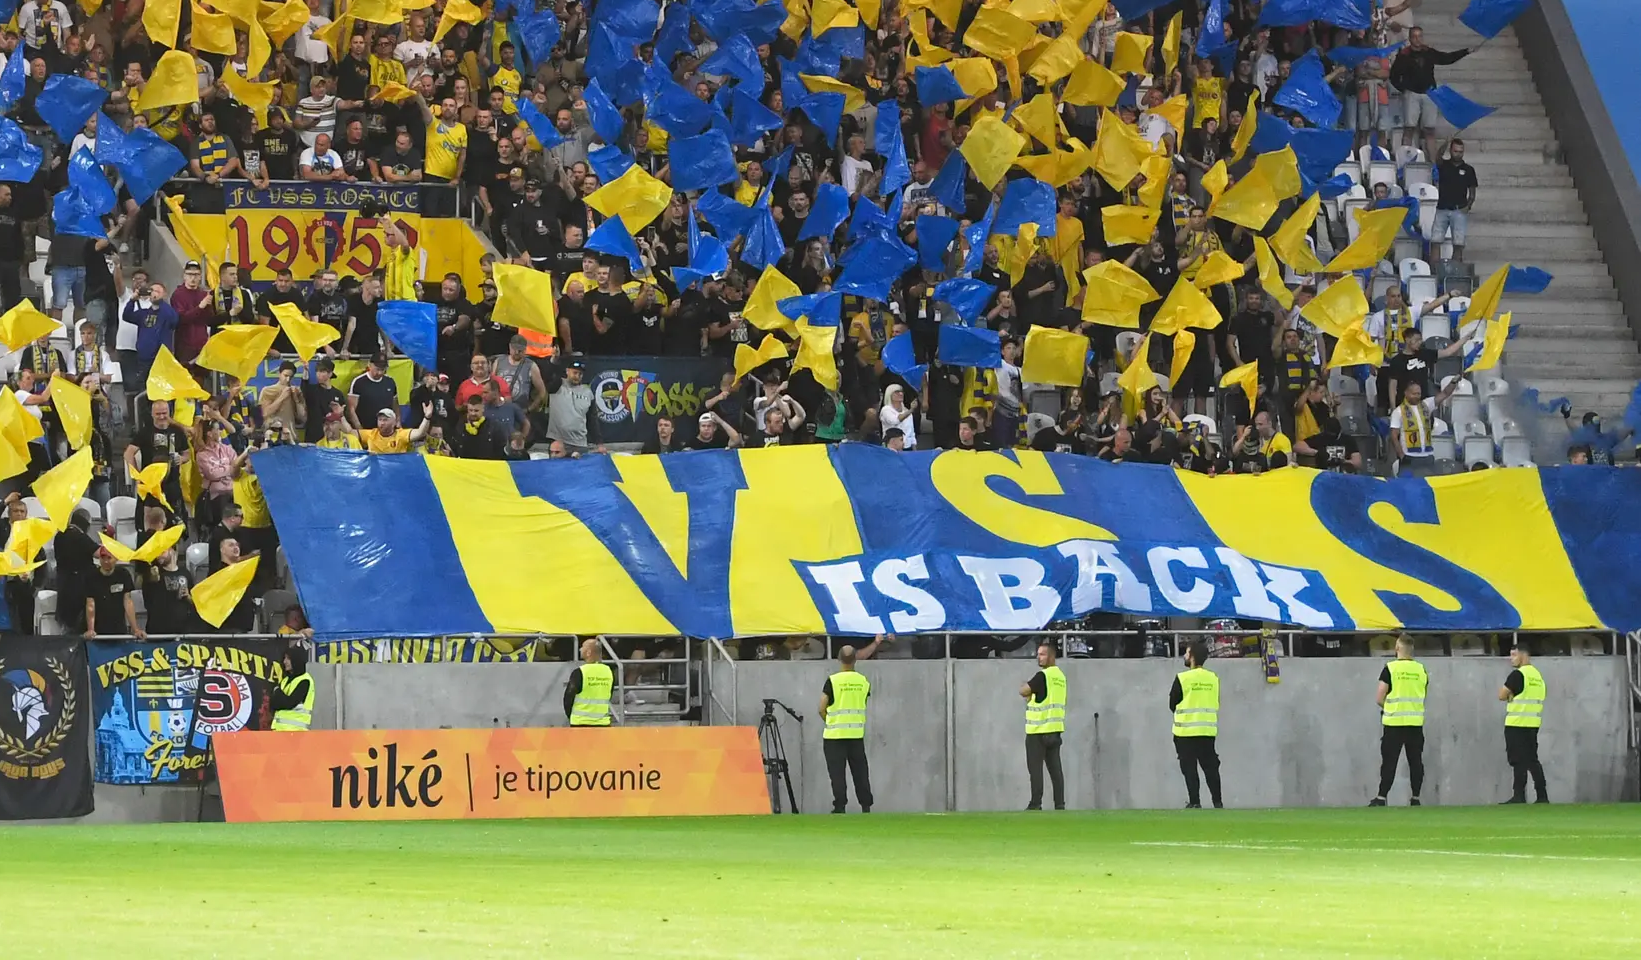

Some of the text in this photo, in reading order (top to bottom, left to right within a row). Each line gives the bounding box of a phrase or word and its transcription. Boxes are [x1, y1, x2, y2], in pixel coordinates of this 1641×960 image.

[228, 187, 261, 208] FC
[268, 187, 317, 206] VSS
[807, 539, 1336, 635] IS BACK
[96, 643, 285, 689] VSS & SPARTA
[196, 720, 241, 735] FOTBAL
[328, 742, 444, 809] niké
[492, 763, 662, 800] je tipovanie
